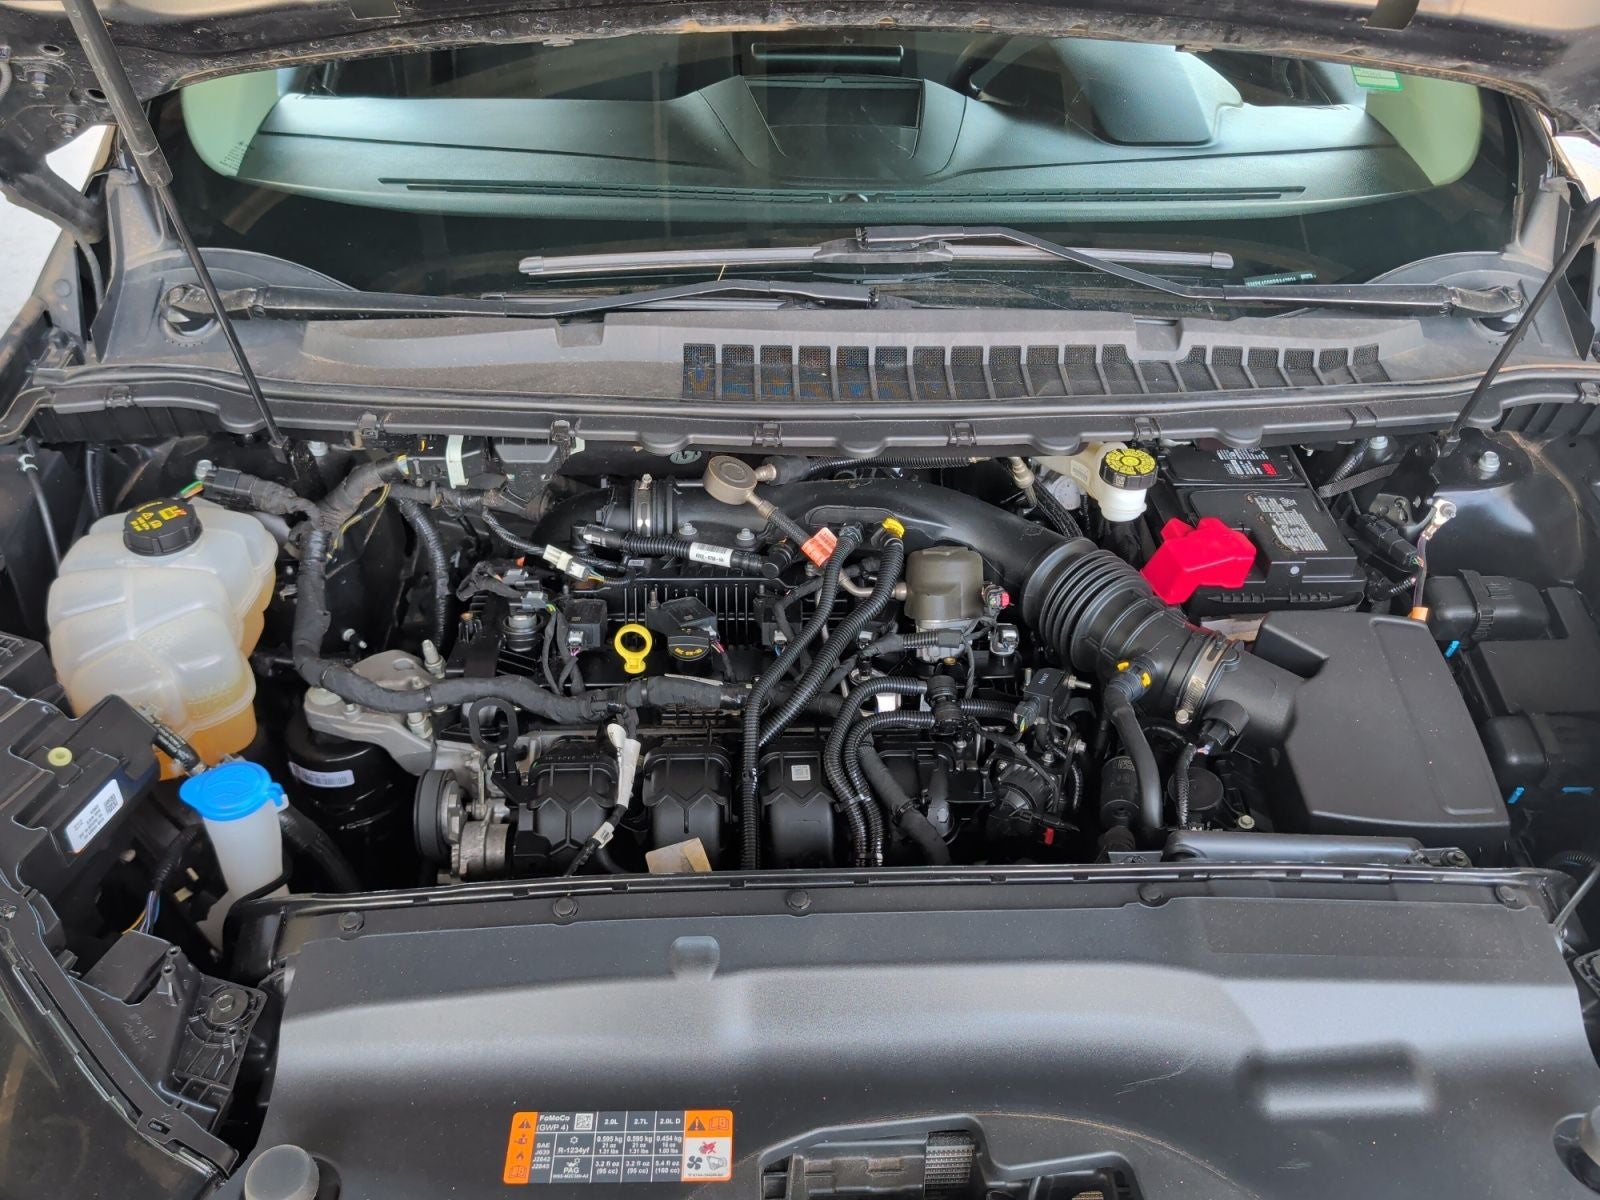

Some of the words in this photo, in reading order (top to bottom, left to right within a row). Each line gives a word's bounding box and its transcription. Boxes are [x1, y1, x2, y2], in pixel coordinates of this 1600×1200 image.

[539, 1114, 571, 1122] FoMoCo
[536, 1124, 559, 1132] (GWP
[561, 1124, 569, 1132] 4)
[614, 1135, 623, 1144] kg
[644, 1135, 653, 1144] kg
[673, 1135, 682, 1143] kg
[557, 1146, 590, 1155] R-1234yf
[563, 1166, 580, 1174] PAG
